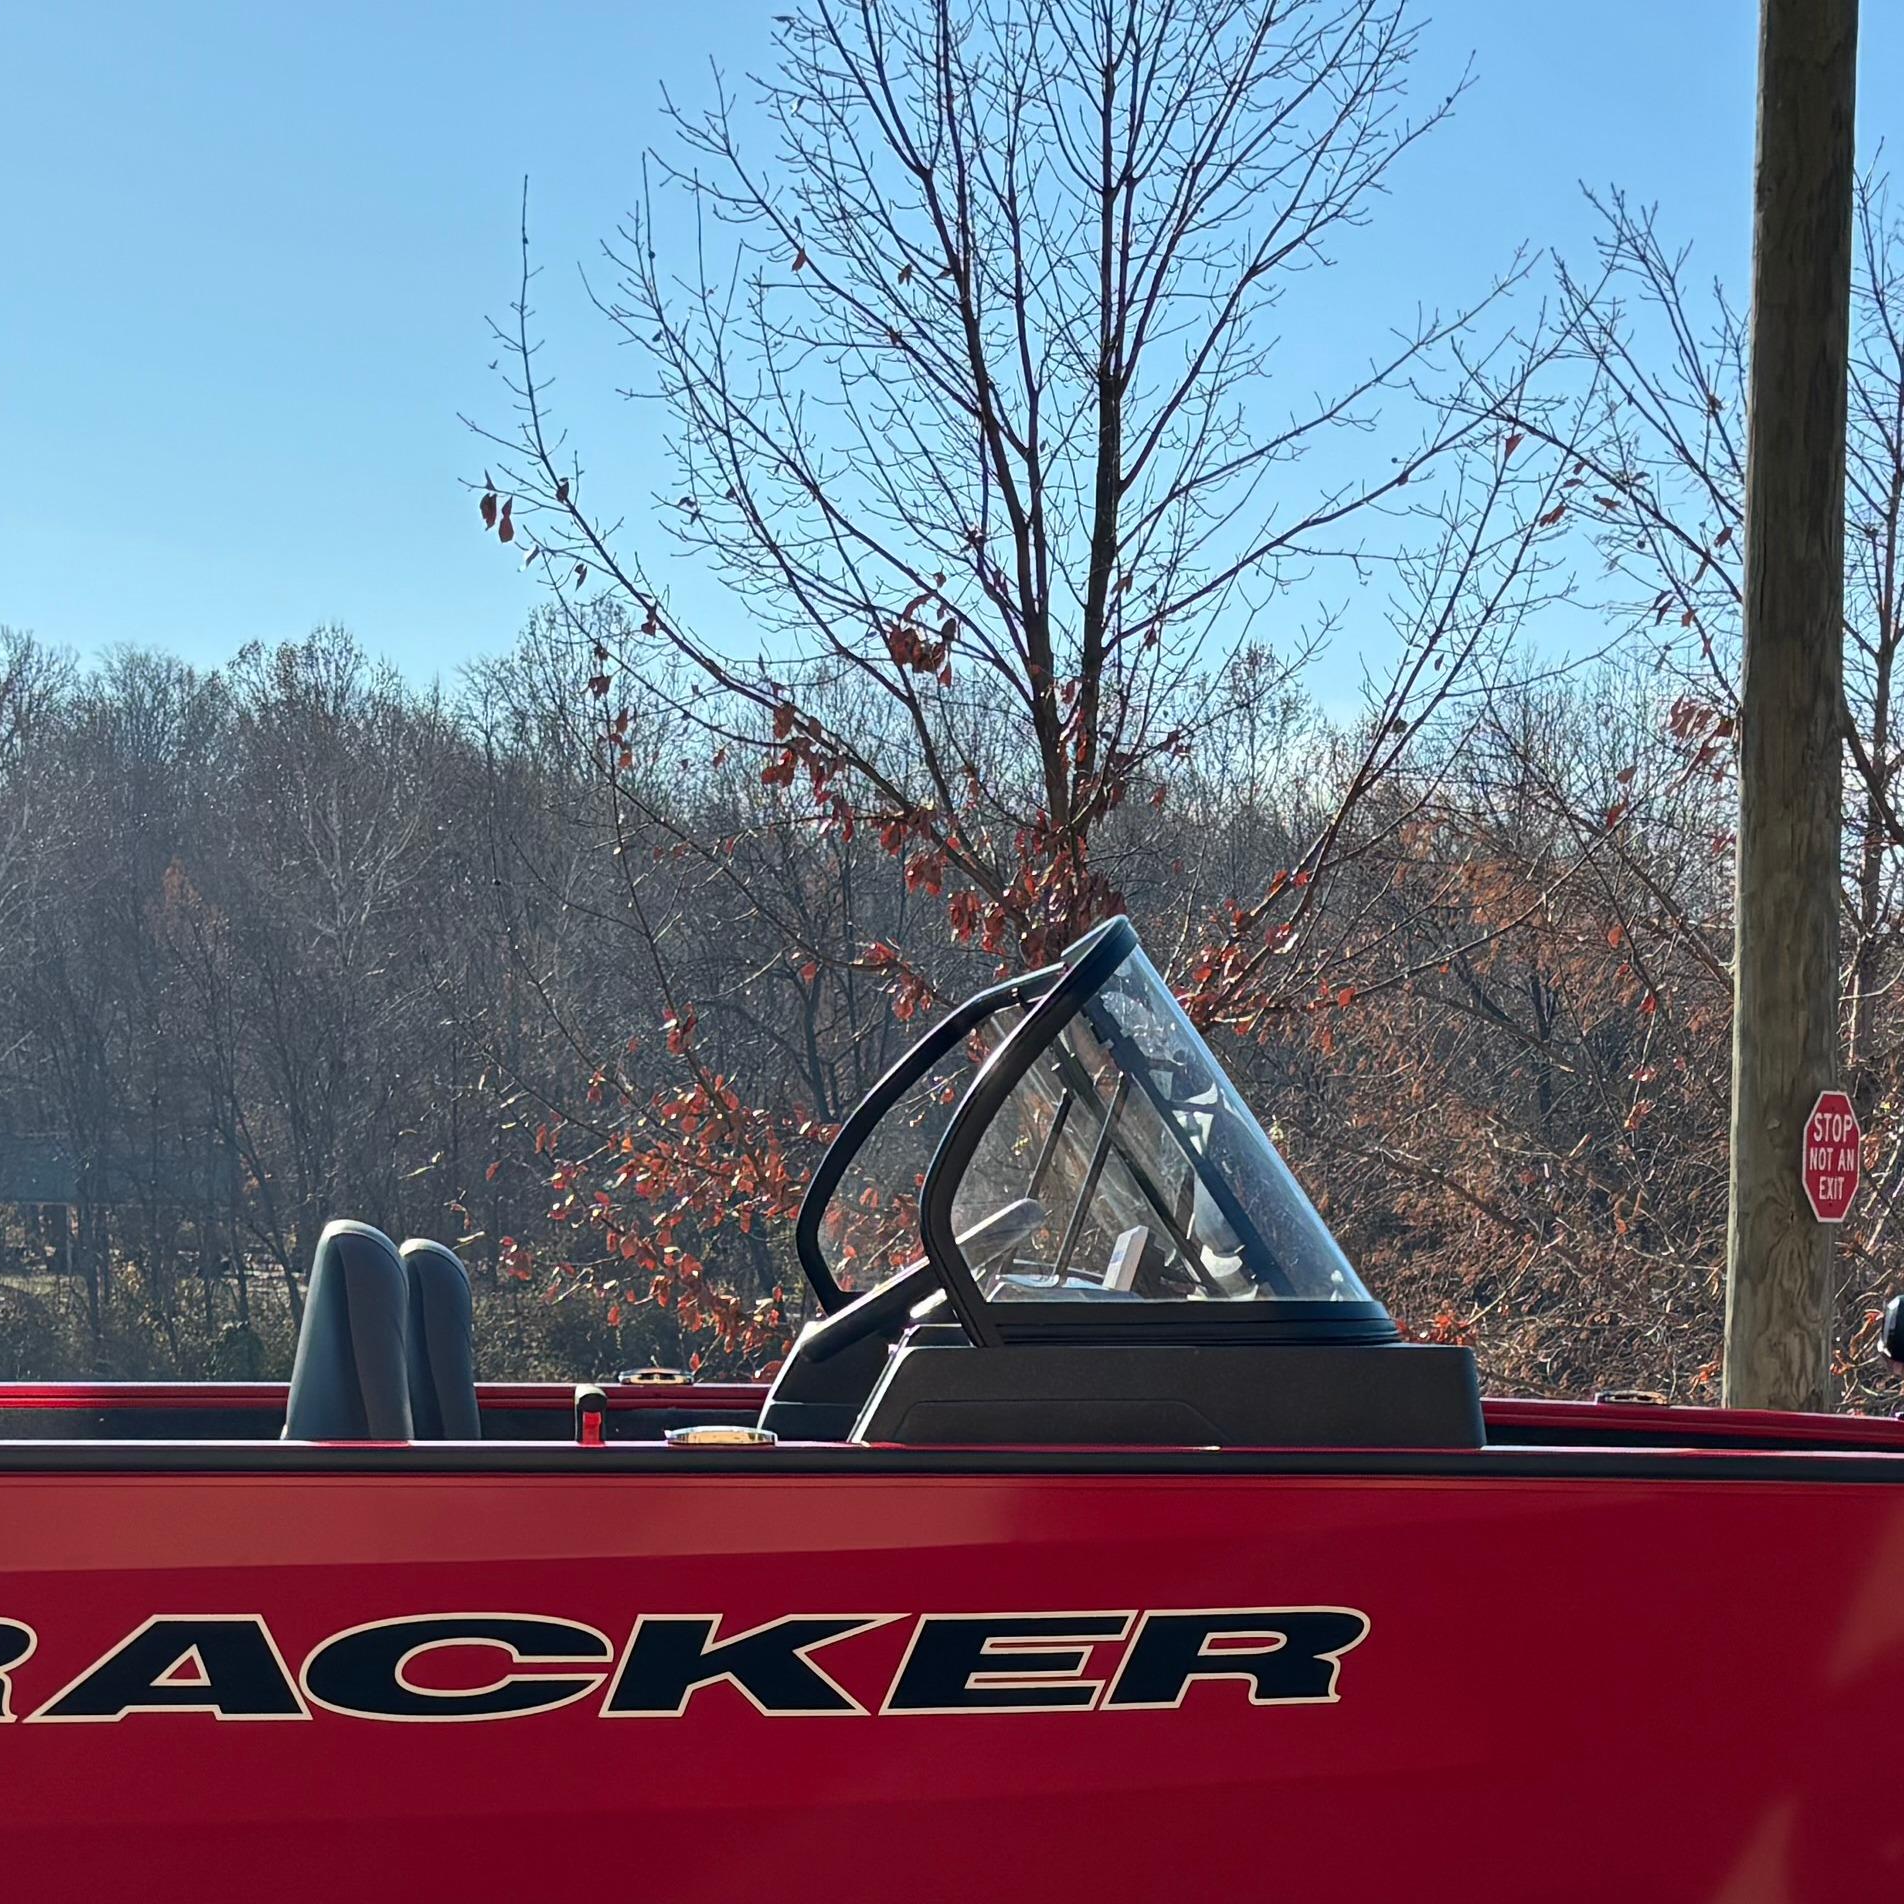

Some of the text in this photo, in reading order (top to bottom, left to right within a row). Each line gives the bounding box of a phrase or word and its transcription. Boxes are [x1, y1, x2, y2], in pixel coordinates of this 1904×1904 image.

[1813, 1112, 1853, 1142] STOP
[1809, 1147, 1854, 1171] NOT AN
[1818, 1176, 1844, 1200] EXIT
